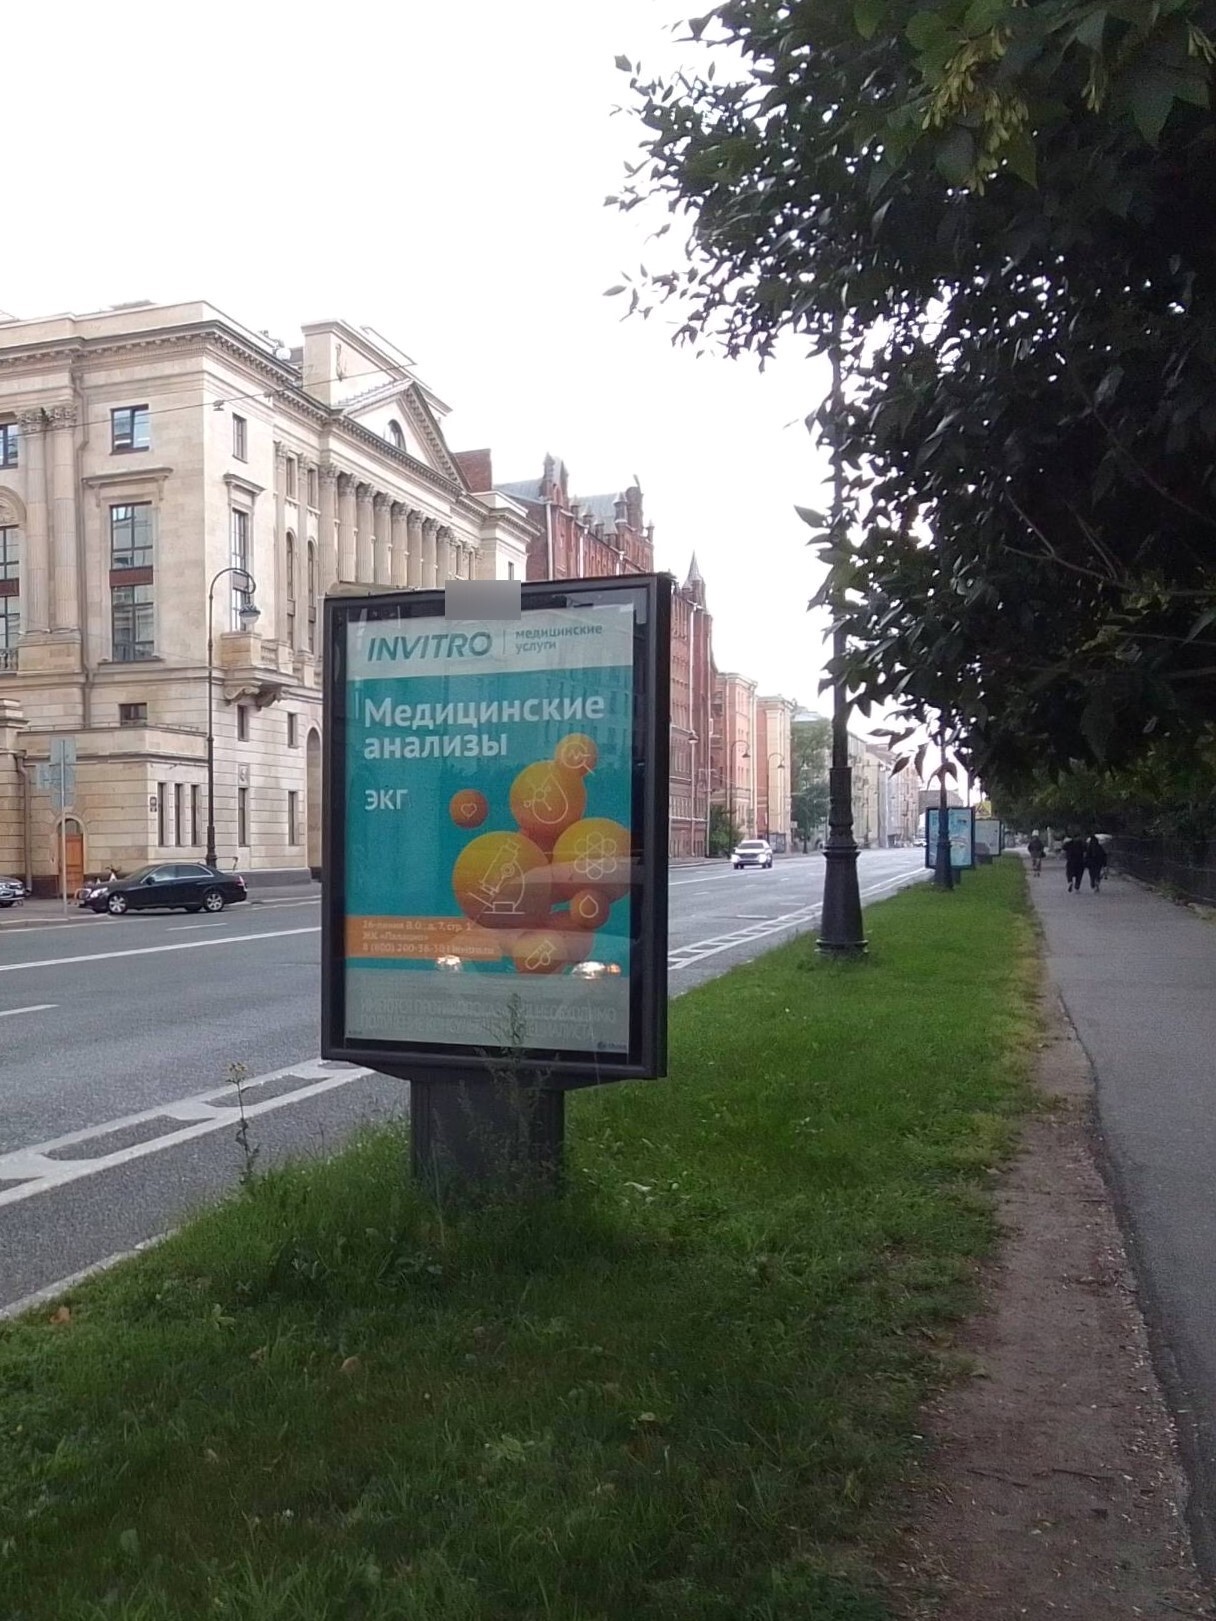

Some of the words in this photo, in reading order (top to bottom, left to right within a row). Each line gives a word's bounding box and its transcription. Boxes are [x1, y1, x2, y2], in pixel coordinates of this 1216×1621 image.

[515, 624, 603, 640] медицинские
[367, 631, 493, 662] INVITRO
[515, 640, 557, 655] услуги
[364, 694, 605, 730] Медицинские
[364, 733, 508, 760] анализы
[365, 789, 408, 810] ЭКГ
